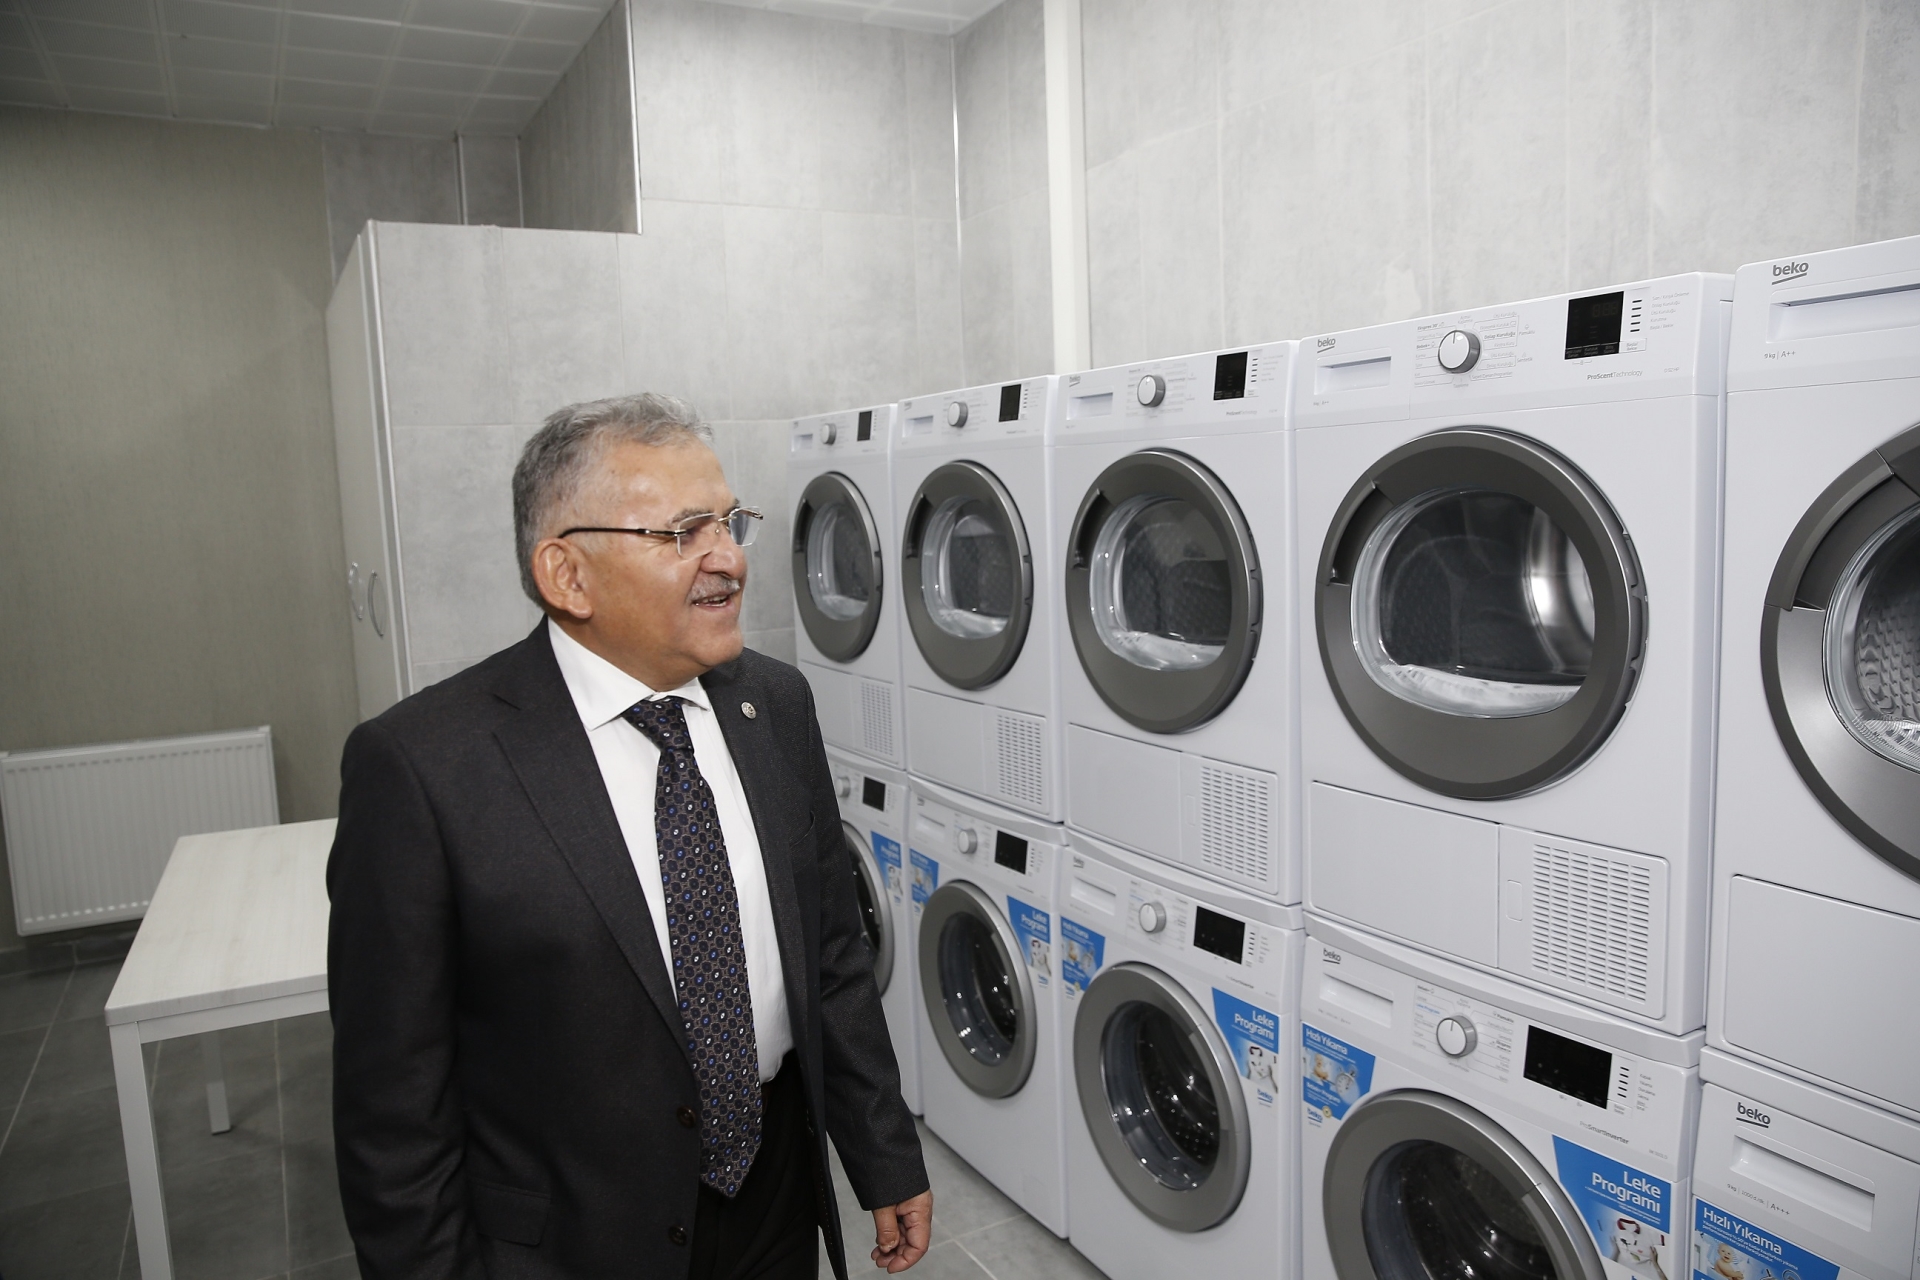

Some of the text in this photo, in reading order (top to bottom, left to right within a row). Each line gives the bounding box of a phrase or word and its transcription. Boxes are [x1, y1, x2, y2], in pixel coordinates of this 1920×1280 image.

[1772, 261, 1809, 277] beko
[1317, 338, 1336, 347] beko
[1587, 370, 1643, 380] ProScentTechnology
[1323, 948, 1341, 961] beko
[1234, 1013, 1274, 1040] Programı
[1252, 1010, 1274, 1029] Leke
[1737, 1102, 1770, 1125] beko
[1592, 1172, 1660, 1214] Programı
[1623, 1171, 1661, 1199] Leke
[1770, 1203, 1790, 1215] A+++
[1704, 1208, 1782, 1255] Hızlı Yıkama
